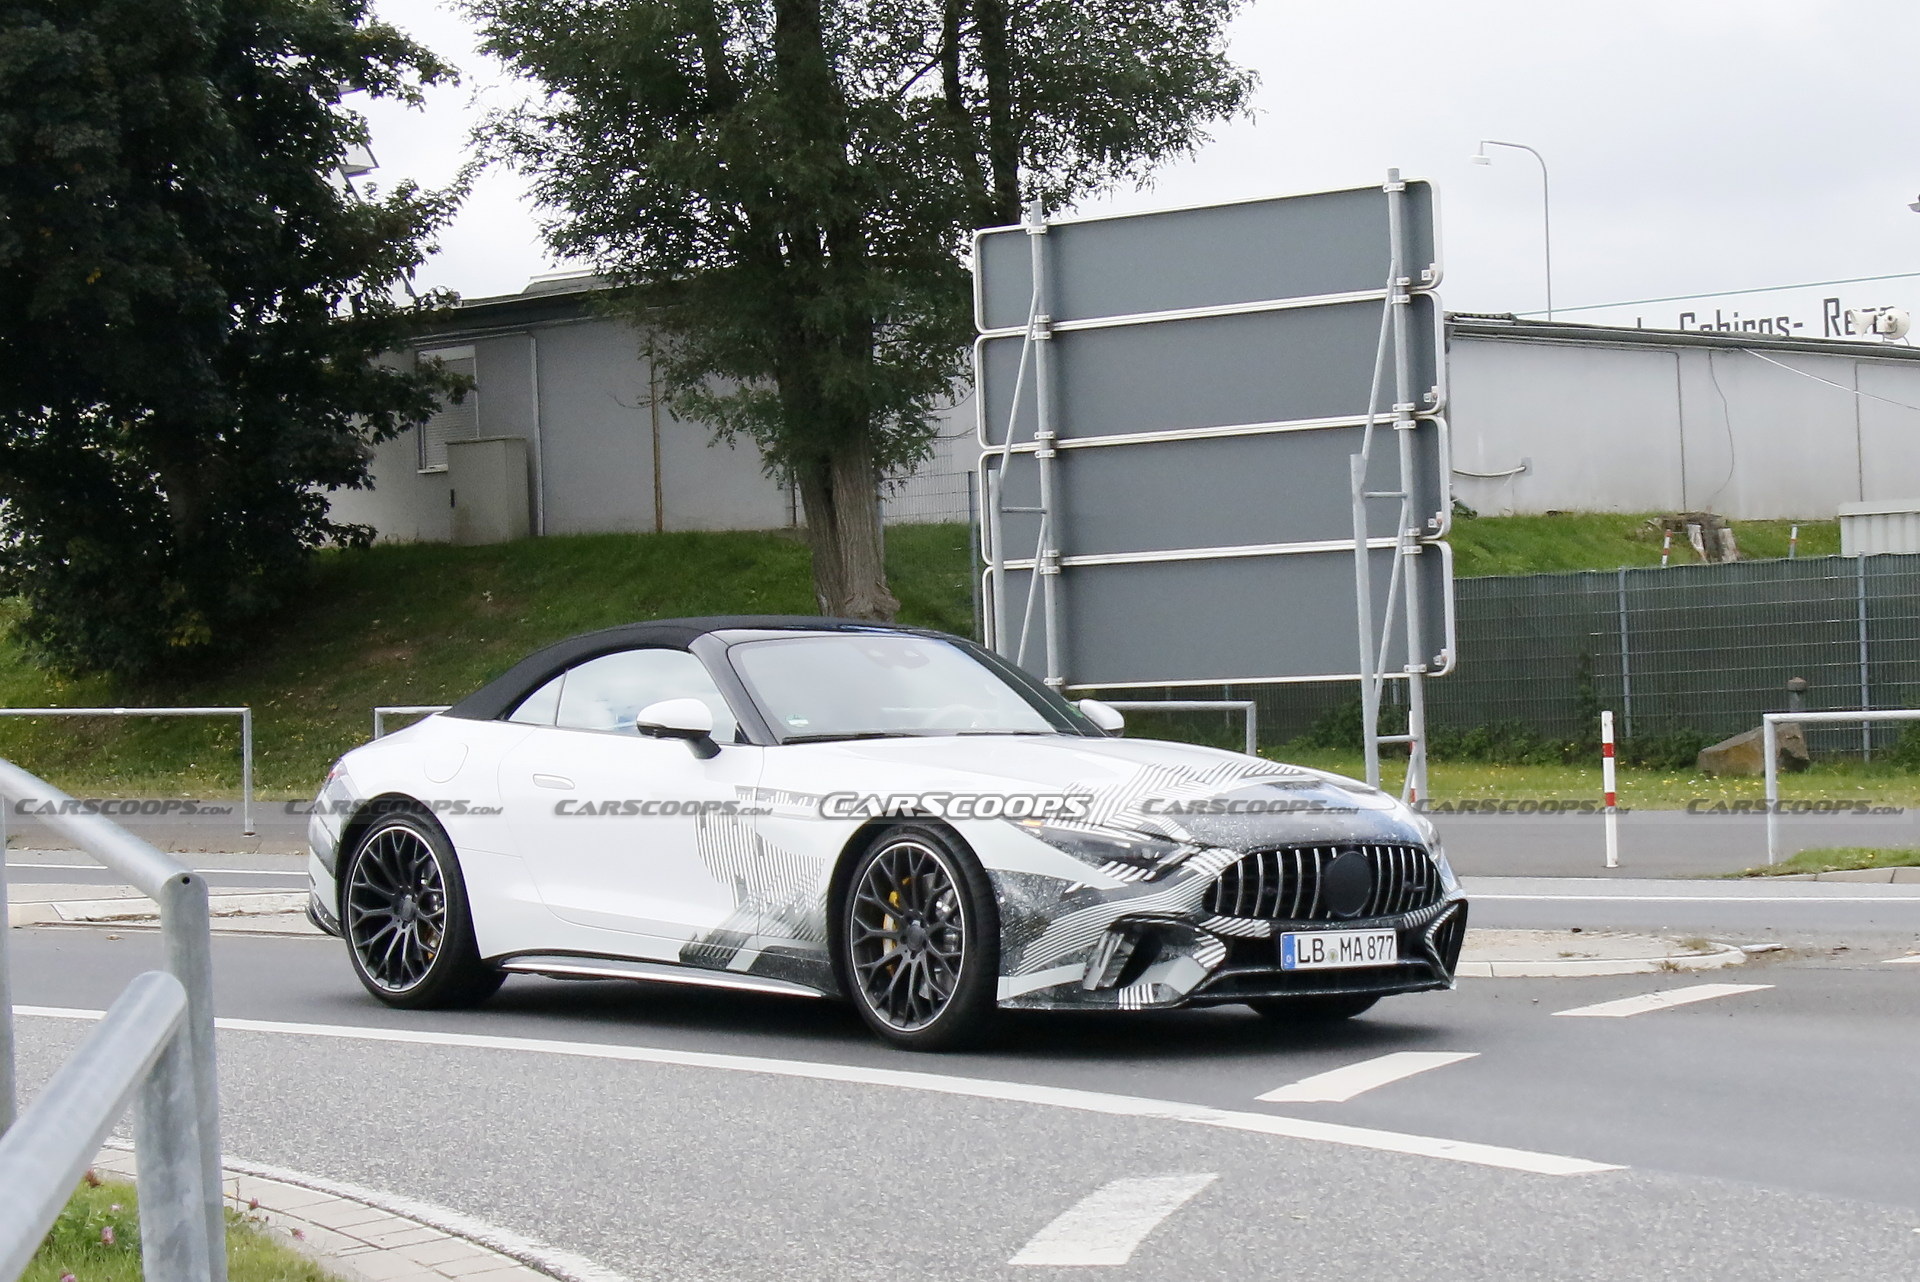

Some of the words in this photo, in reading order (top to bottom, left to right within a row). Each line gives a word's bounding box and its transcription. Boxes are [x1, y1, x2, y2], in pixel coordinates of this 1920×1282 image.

[1297, 938, 1325, 963] LB
[1340, 936, 1363, 962] MA
[1367, 935, 1394, 960] 877
